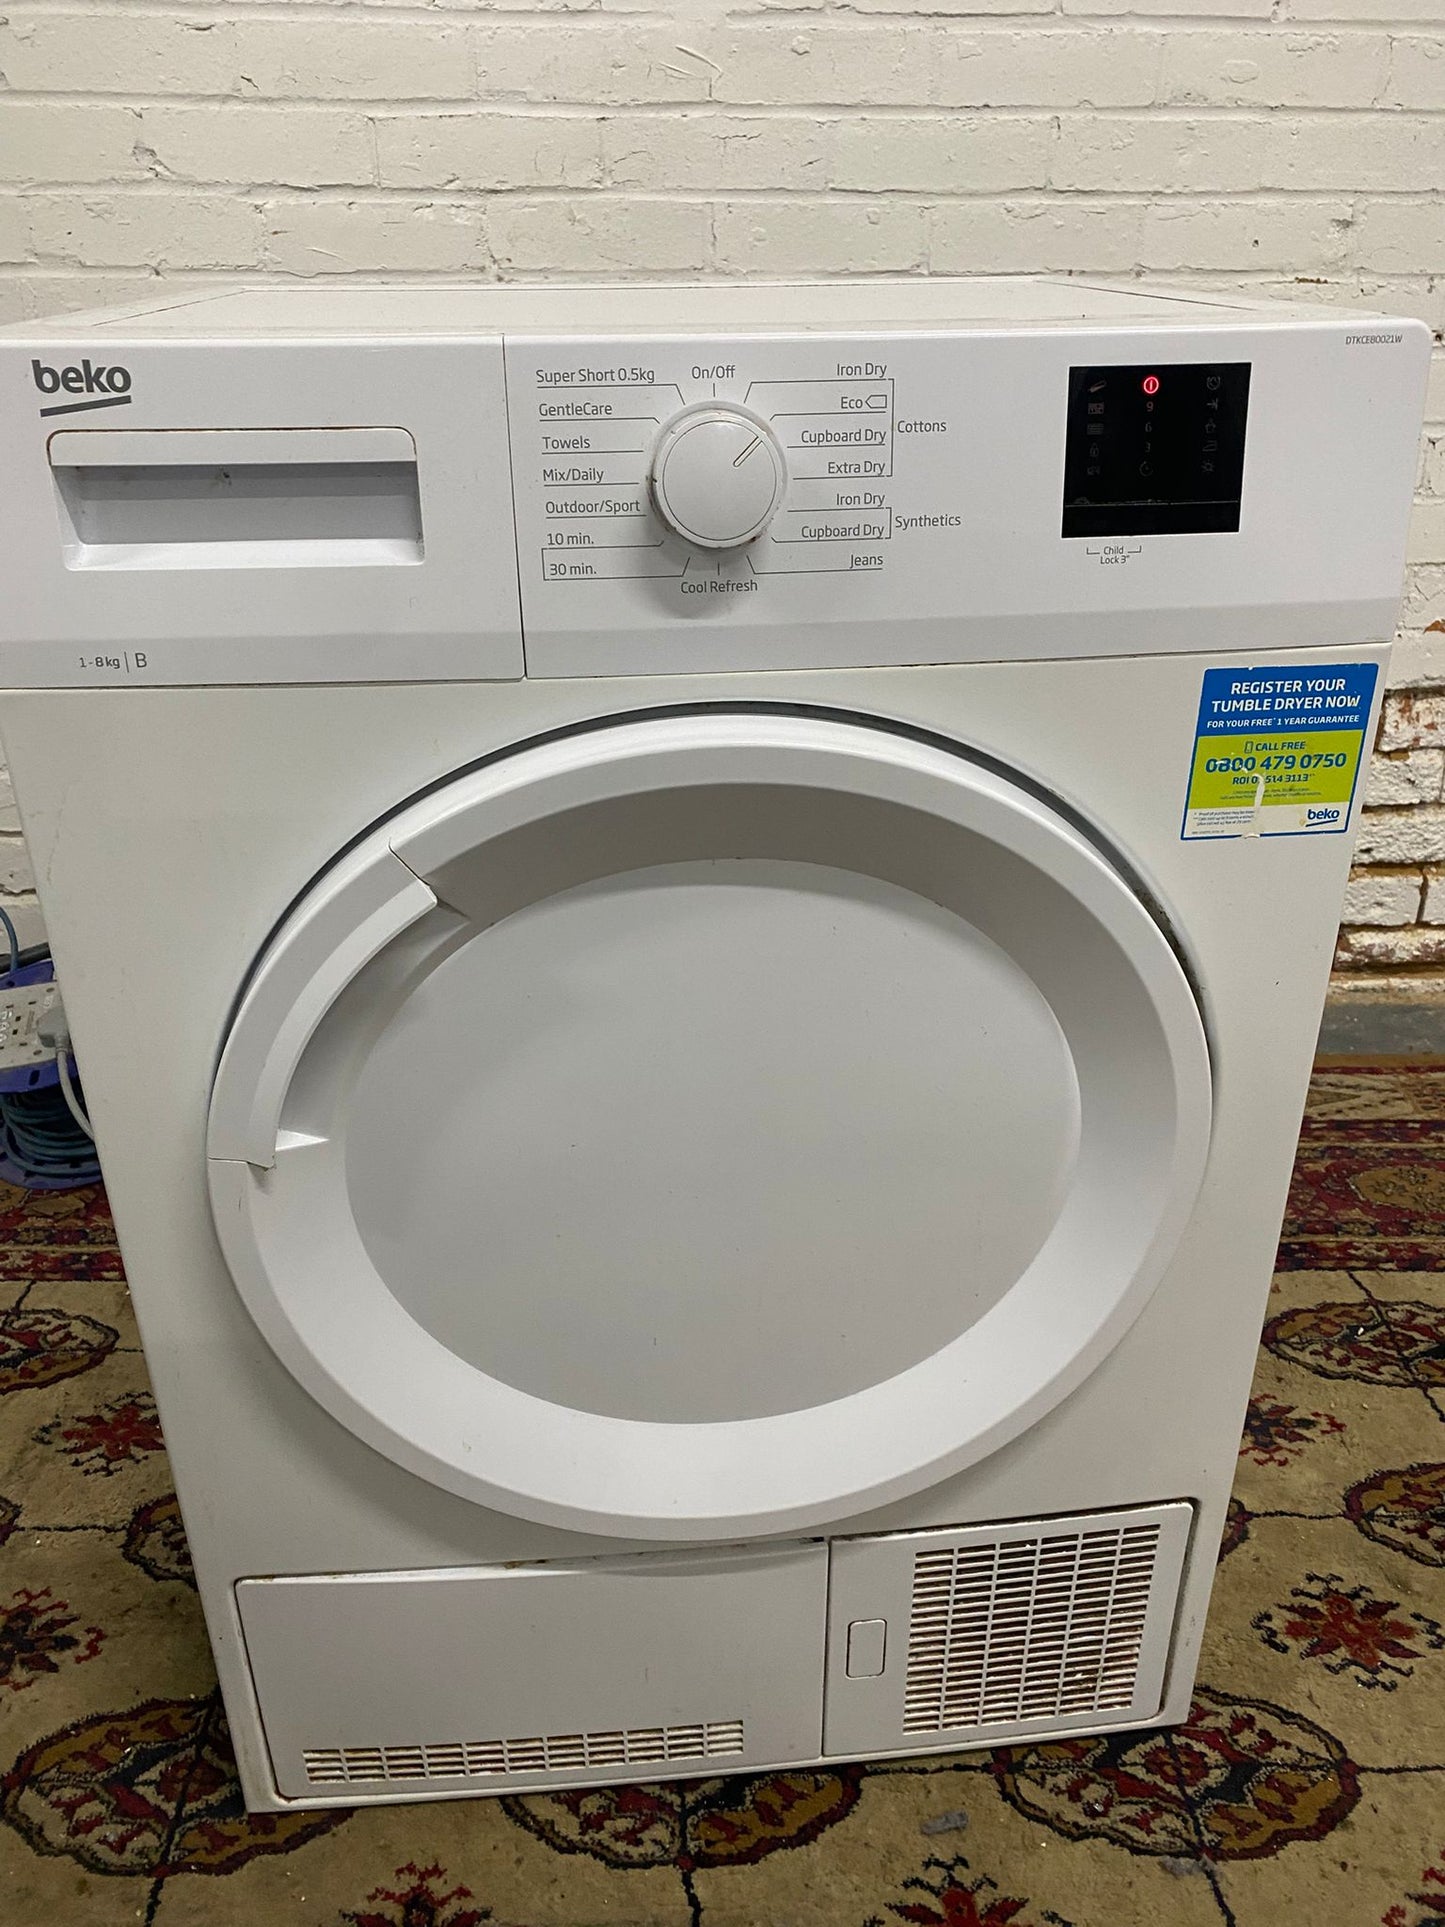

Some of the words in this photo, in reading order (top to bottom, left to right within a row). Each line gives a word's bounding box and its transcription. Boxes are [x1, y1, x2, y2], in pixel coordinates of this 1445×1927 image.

[31, 359, 132, 394] beko
[536, 369, 575, 385] Super
[579, 368, 615, 382] Short
[617, 368, 655, 384] 0.5kg
[691, 365, 736, 379] On/Off
[837, 363, 862, 376] Iron
[865, 362, 887, 379] Dry
[539, 402, 612, 417] GentleCare
[840, 396, 863, 409] Eco
[897, 420, 947, 433] Cottons
[542, 436, 591, 449] Towels
[801, 429, 862, 445] Cupboard
[864, 428, 886, 444] Dry
[827, 461, 861, 474] Extra
[864, 460, 885, 476] Dry
[543, 468, 604, 484] Mix/Daily
[545, 500, 640, 515] Outdoor/Sport
[836, 493, 861, 506] Iron
[863, 493, 885, 508] Dry
[895, 514, 962, 530] Synthetics
[547, 533, 564, 545] 10
[567, 533, 595, 545] min.
[801, 524, 860, 540] Cupboard
[863, 524, 885, 540] Dry
[1103, 546, 1124, 555] Child
[850, 554, 884, 569] Jeans
[1100, 556, 1119, 565] Lock
[549, 563, 567, 575] 30
[570, 562, 597, 574] min.
[680, 581, 707, 594] Cool
[710, 580, 758, 593] Refresh
[135, 652, 148, 668] B
[1230, 680, 1302, 695] REGISTER
[1305, 678, 1347, 692] YOUR
[1211, 698, 1272, 713] TUMBLE
[1274, 696, 1322, 711] DRYER
[1325, 695, 1361, 708] NOW
[1207, 720, 1224, 728] FOR
[1226, 719, 1250, 728] YOUR
[1277, 718, 1281, 726] 1
[1284, 717, 1309, 725] YEAR
[1308, 715, 1360, 724] GUARANTEE
[1255, 742, 1279, 752] CALL
[1281, 741, 1306, 750] FREE
[1205, 757, 1256, 773] 0800
[1260, 754, 1296, 771] 479
[1299, 753, 1347, 769] 0750
[1232, 776, 1249, 785] ROI
[1307, 808, 1340, 820] beko
